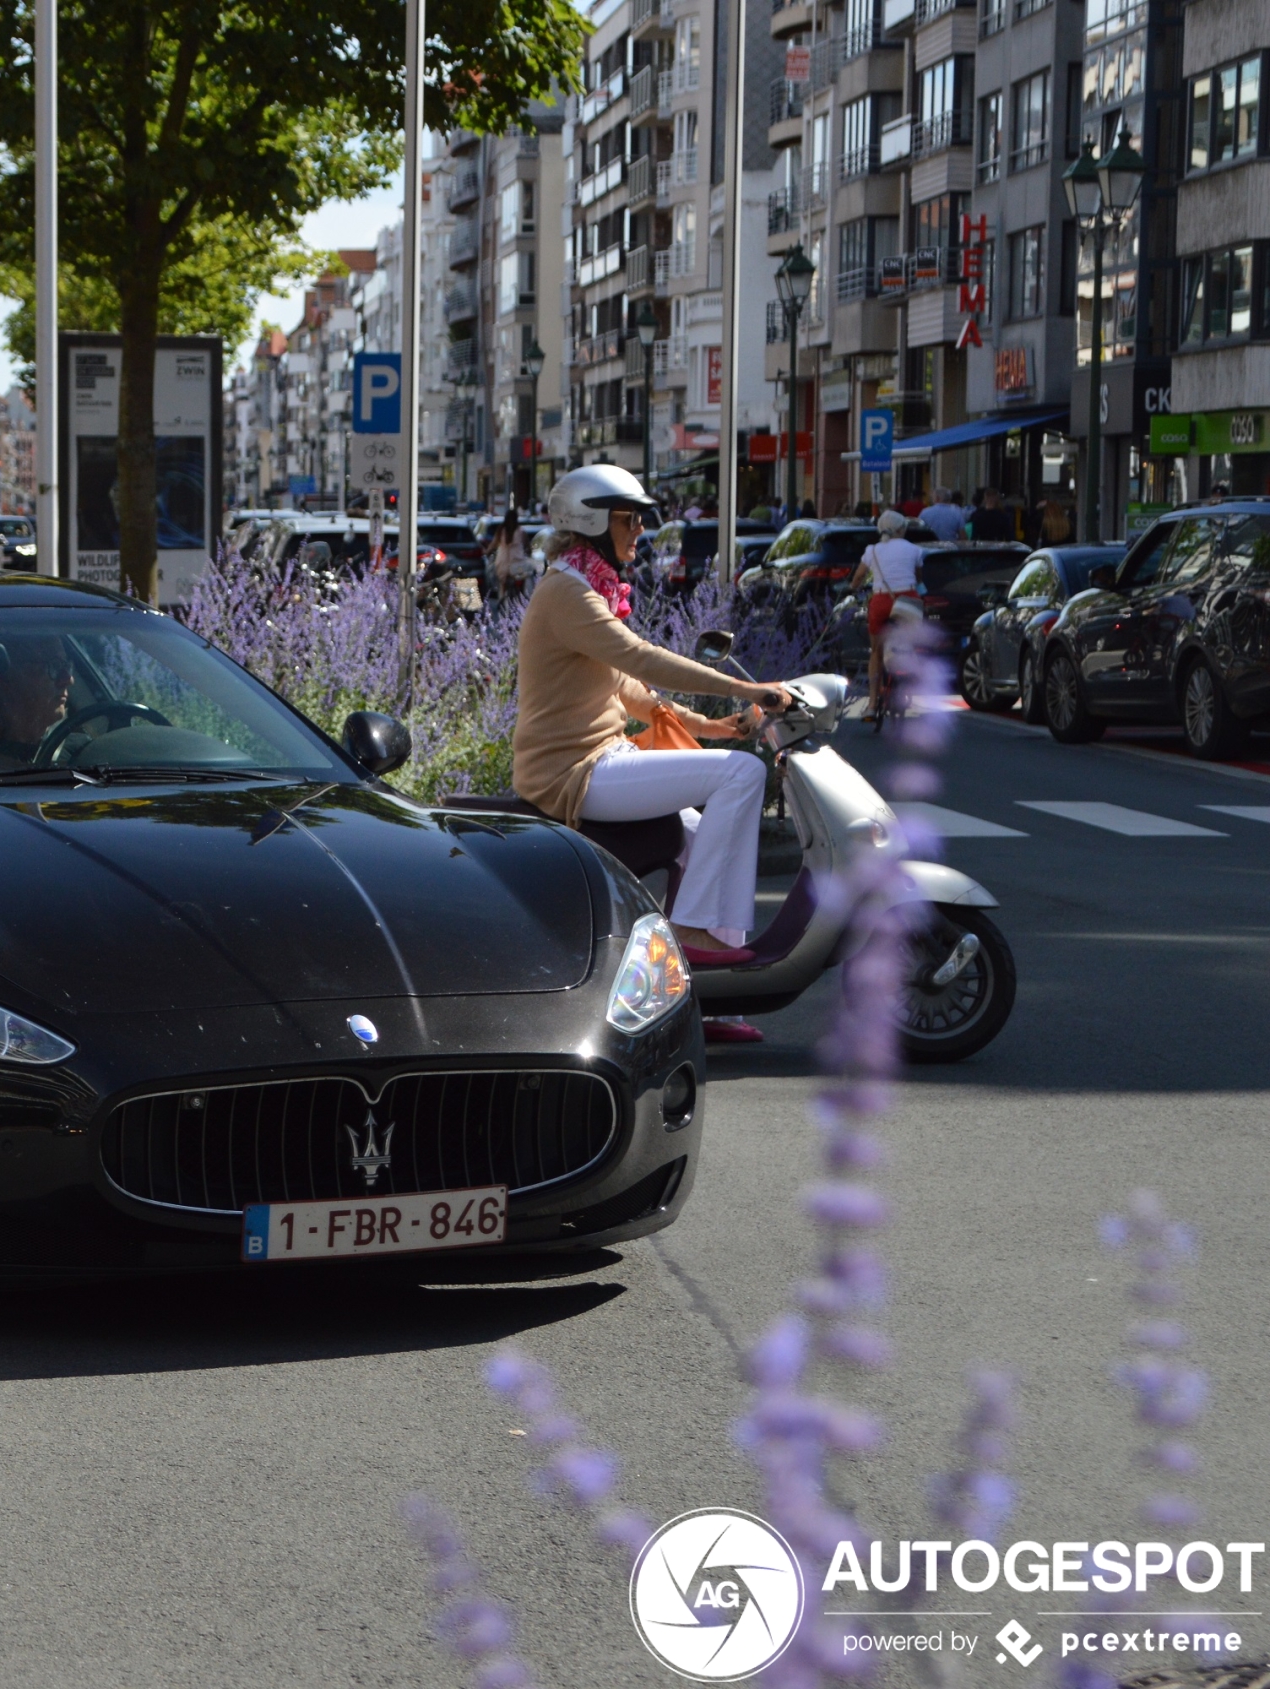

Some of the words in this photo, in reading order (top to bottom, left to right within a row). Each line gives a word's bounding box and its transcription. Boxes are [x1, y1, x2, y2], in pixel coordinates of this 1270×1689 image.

[959, 213, 987, 350] HEMA
[994, 347, 1027, 390] HEMA
[361, 364, 399, 422] P
[865, 416, 888, 449] P
[77, 554, 120, 566] WILDLIF
[248, 1236, 263, 1254] B
[280, 1197, 499, 1251] 1-FBR-846
